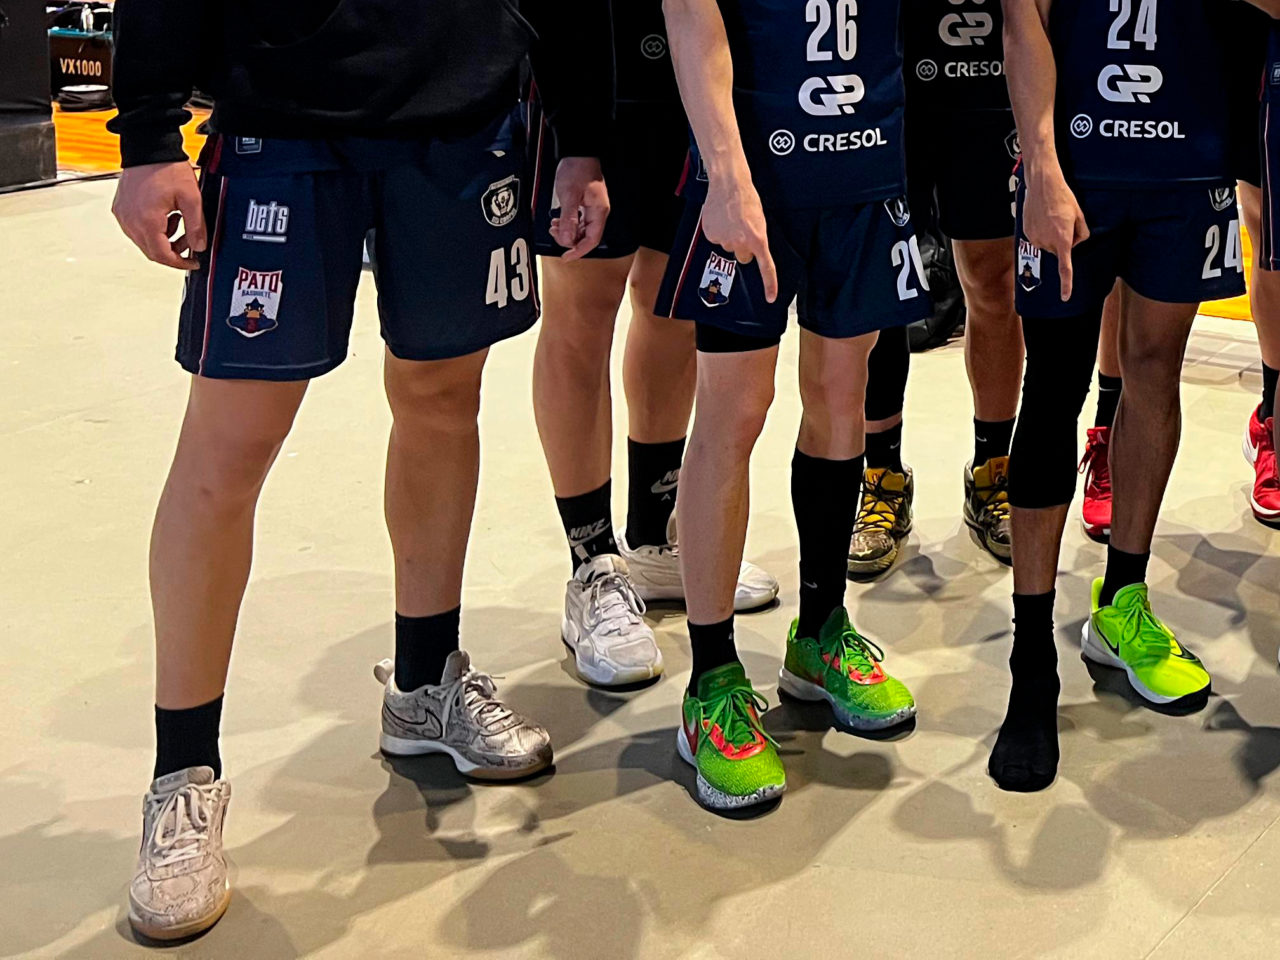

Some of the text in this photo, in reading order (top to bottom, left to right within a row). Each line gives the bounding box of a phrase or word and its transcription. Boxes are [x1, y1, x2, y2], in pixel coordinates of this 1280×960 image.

[59, 57, 102, 77] VX1000
[944, 60, 1006, 78] CRESO
[803, 127, 888, 152] CRESOL
[1099, 119, 1186, 139] CRESOL
[245, 199, 290, 235] bets
[1201, 220, 1243, 281] 24
[485, 237, 530, 309] 43
[708, 253, 736, 278] PATO
[238, 268, 282, 294] PATO
[570, 517, 606, 539] NIKE
